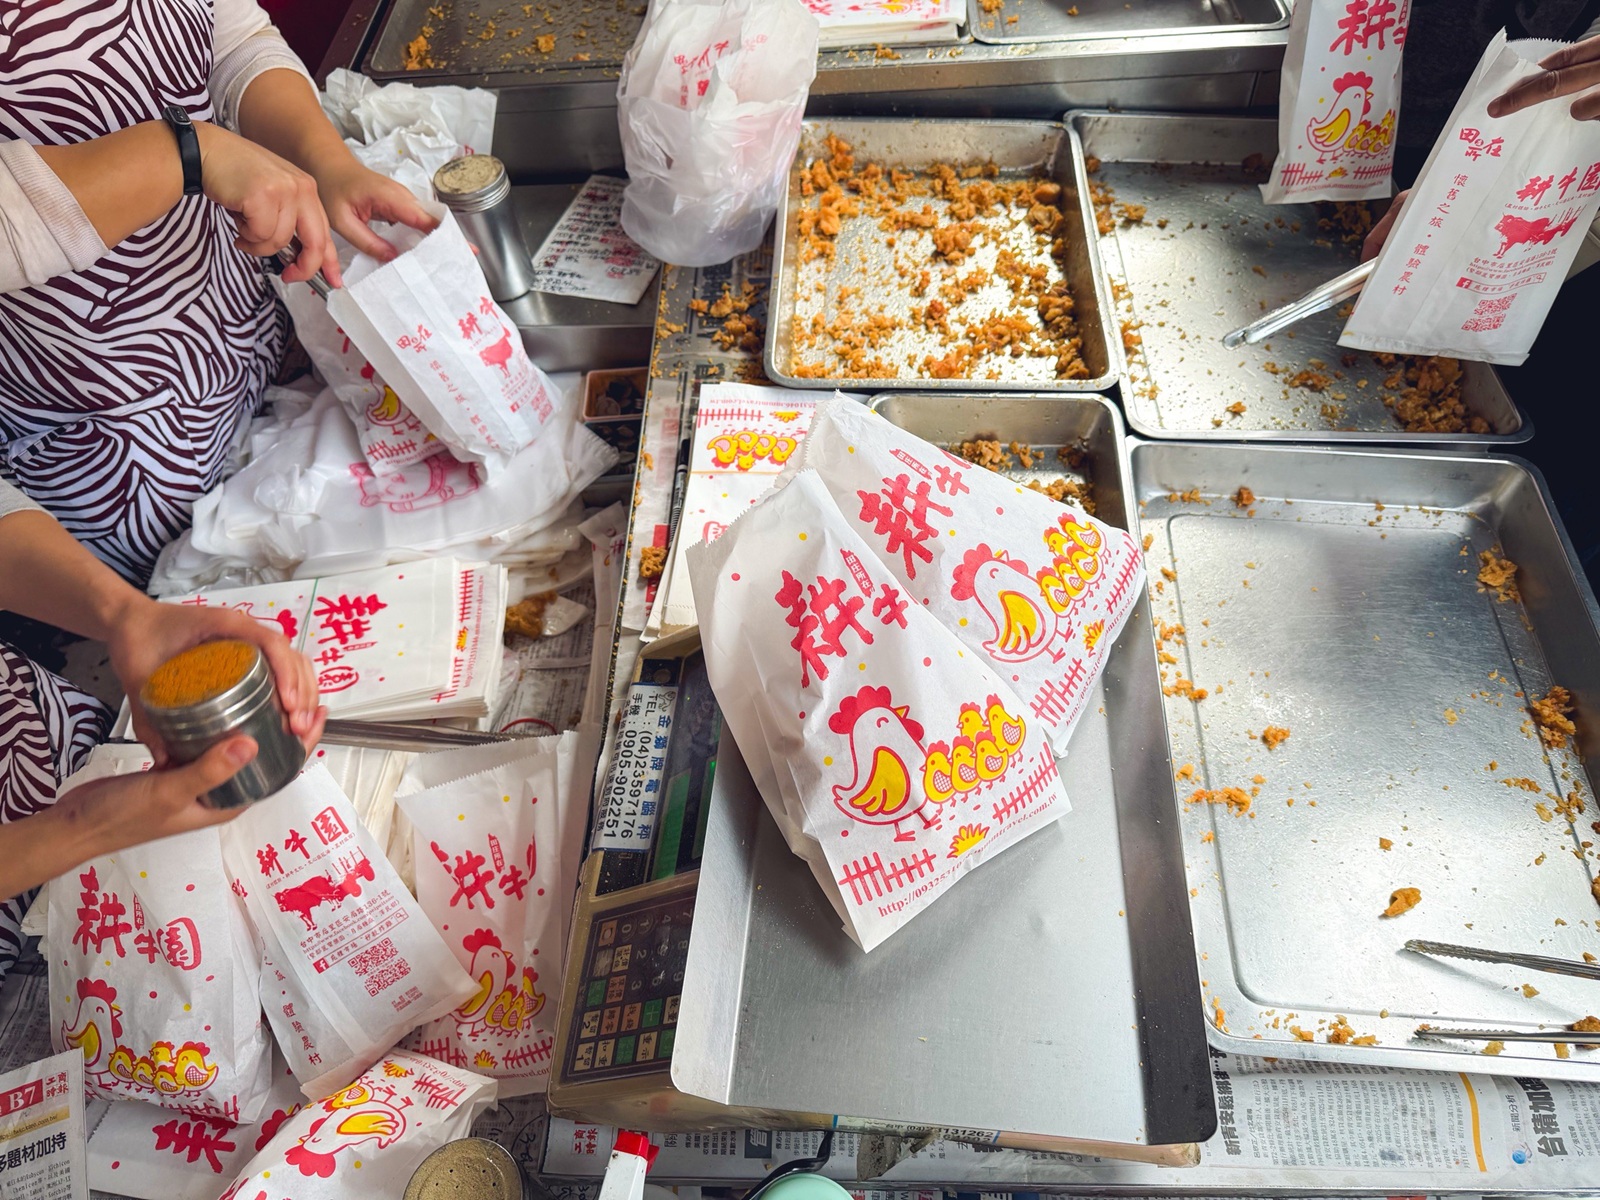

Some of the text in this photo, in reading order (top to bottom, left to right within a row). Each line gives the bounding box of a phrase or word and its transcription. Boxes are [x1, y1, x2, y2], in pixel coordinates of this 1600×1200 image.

[256, 805, 350, 878] 耕牛園
[72, 865, 202, 971] 耕牛園
[636, 949, 647, 960] 2
[631, 980, 642, 991] 3
[673, 971, 684, 982] 9
[8, 1085, 36, 1112] B7
[1505, 1093, 1521, 1133] 新聞分析
